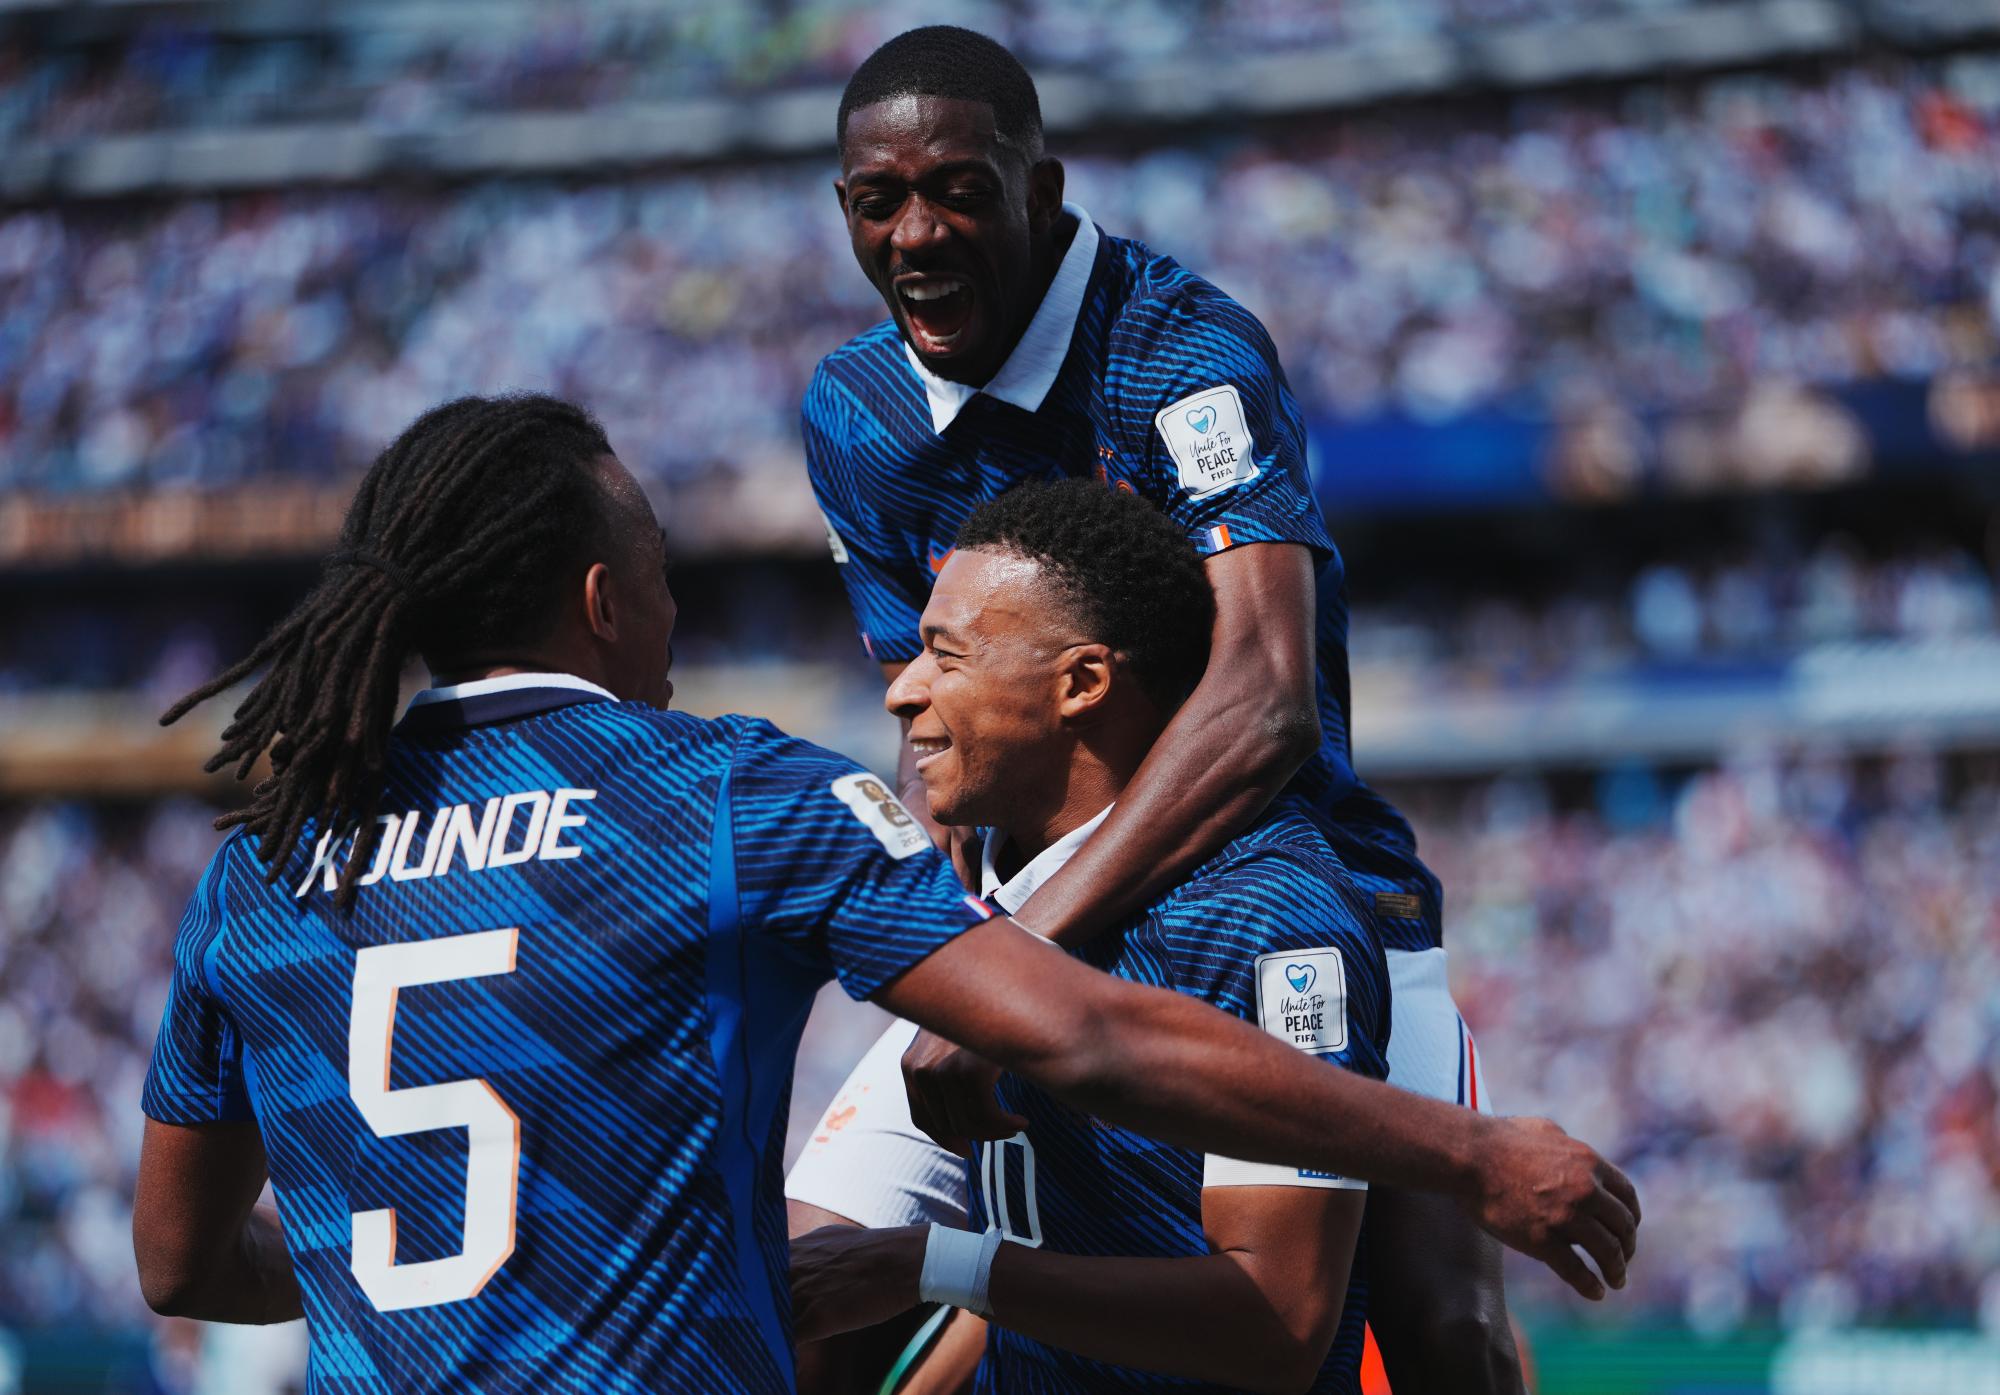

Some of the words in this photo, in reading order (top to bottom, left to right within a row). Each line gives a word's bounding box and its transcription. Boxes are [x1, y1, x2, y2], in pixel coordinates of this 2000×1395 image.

[1189, 438, 1217, 458] Unite
[1217, 431, 1231, 447] For
[1197, 447, 1238, 474] PEACE
[1210, 468, 1233, 481] FIFA
[1280, 996, 1310, 1014] Unite
[1310, 994, 1326, 1010] For
[1285, 1013, 1324, 1032] PEACE
[1295, 1034, 1317, 1043] FIFA
[348, 928, 521, 1312] 5
